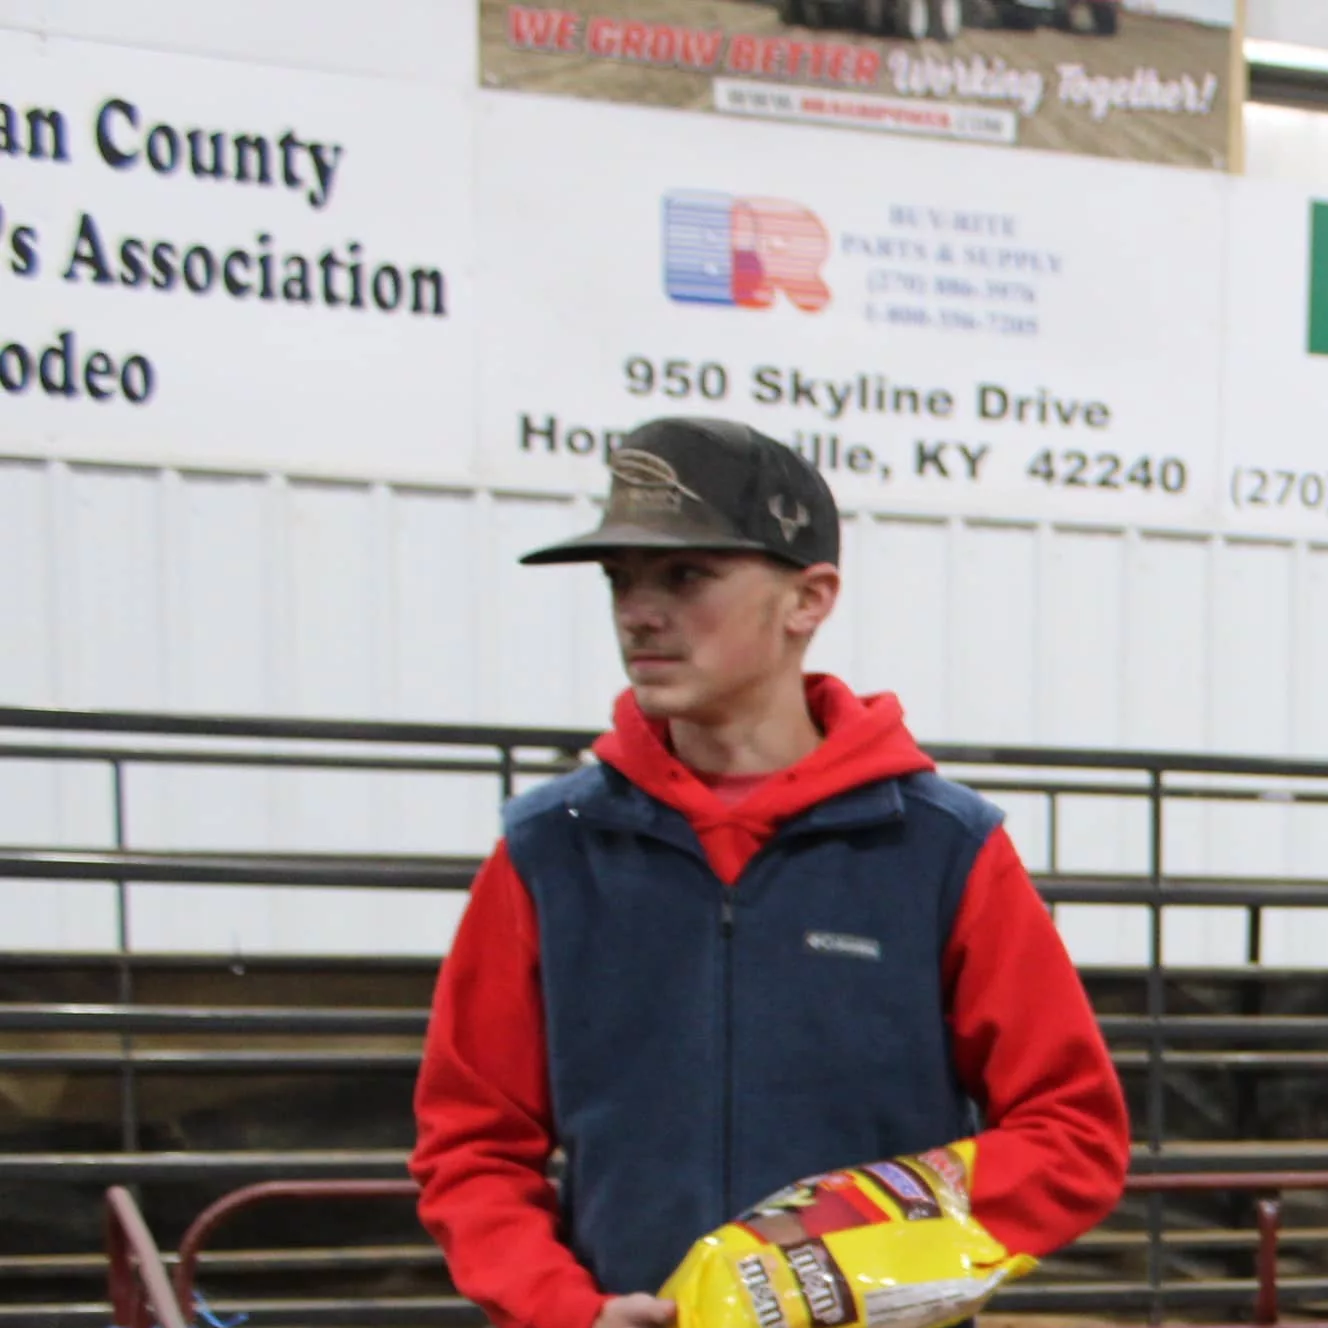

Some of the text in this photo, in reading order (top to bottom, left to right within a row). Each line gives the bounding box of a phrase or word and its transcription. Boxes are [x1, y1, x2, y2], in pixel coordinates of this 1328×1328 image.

[508, 6, 1217, 123] WE GROW BETTER Working Together!
[97, 98, 344, 209] County
[63, 210, 447, 317] Association
[840, 231, 1063, 275] PARTS & SUPPLY
[624, 356, 1112, 429] 950 Skyline Drive
[915, 438, 990, 481] KY
[1026, 447, 1189, 493] 42240
